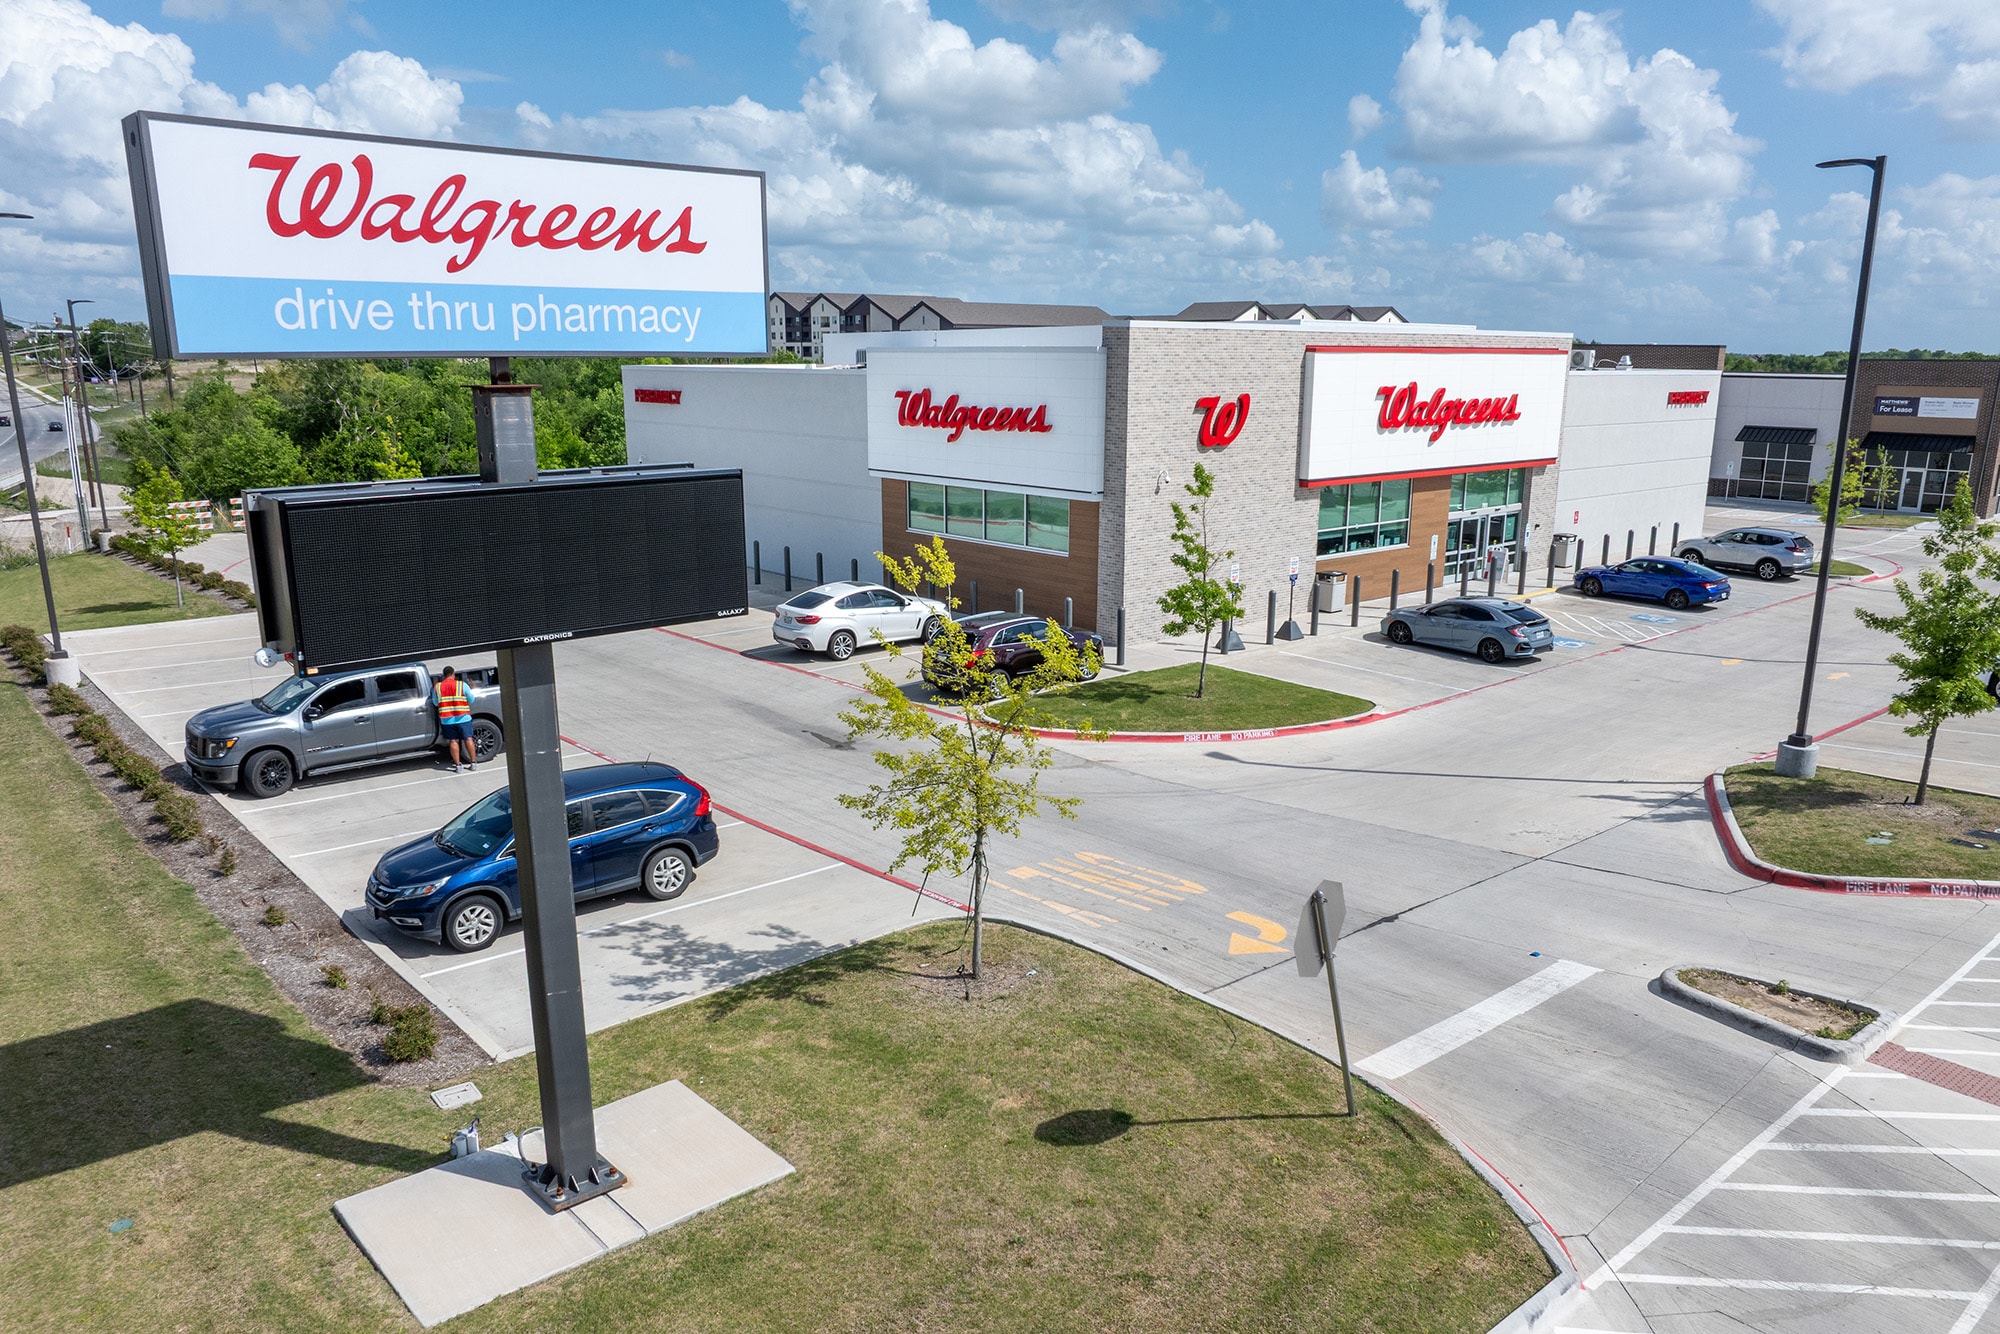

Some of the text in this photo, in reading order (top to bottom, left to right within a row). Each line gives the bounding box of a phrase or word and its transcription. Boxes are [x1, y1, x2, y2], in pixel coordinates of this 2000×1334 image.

[249, 153, 707, 273] Walgreens
[274, 287, 702, 343] drive thru pharmacy
[895, 388, 1053, 443] Walgreens
[1195, 392, 1251, 448] W
[1377, 381, 1521, 442] Walgreens
[1879, 405, 1891, 413] For
[1893, 405, 1913, 414] Lease
[523, 631, 573, 644] DAKTRONICS
[1183, 730, 1275, 742] FIRE LANE NO PARKING
[1845, 881, 1874, 893] FIRE
[1877, 882, 1910, 895] LANE
[1930, 884, 1949, 896] NO
